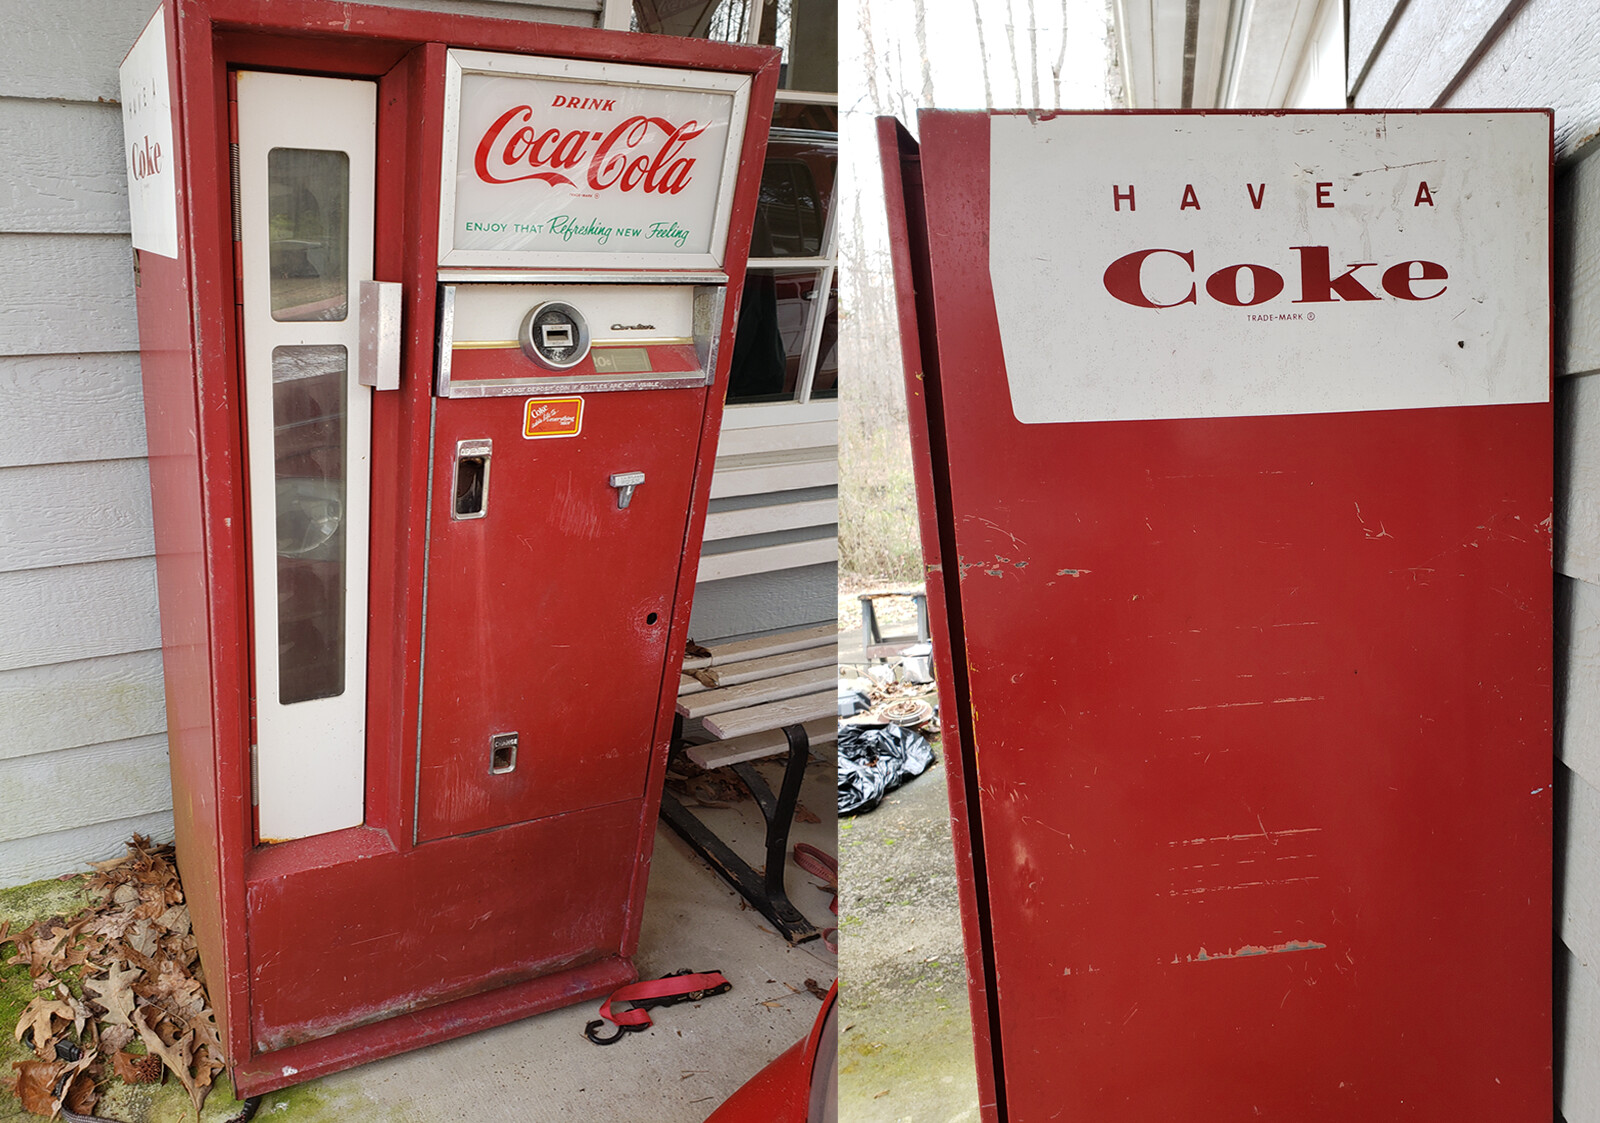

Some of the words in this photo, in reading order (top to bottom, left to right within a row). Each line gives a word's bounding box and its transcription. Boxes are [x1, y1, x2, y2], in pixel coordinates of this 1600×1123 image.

[552, 95, 617, 112] DRINK
[133, 136, 161, 181] Coke
[1112, 182, 1335, 212] HAVE
[1414, 181, 1434, 208] A
[466, 222, 507, 232] ENJOY
[514, 224, 544, 234] THAT
[547, 215, 613, 245] Refreshing
[616, 228, 642, 238] NEW
[645, 222, 691, 248] Feeling
[1103, 246, 1449, 310] Coke
[1247, 312, 1304, 322] TRADE-MARK
